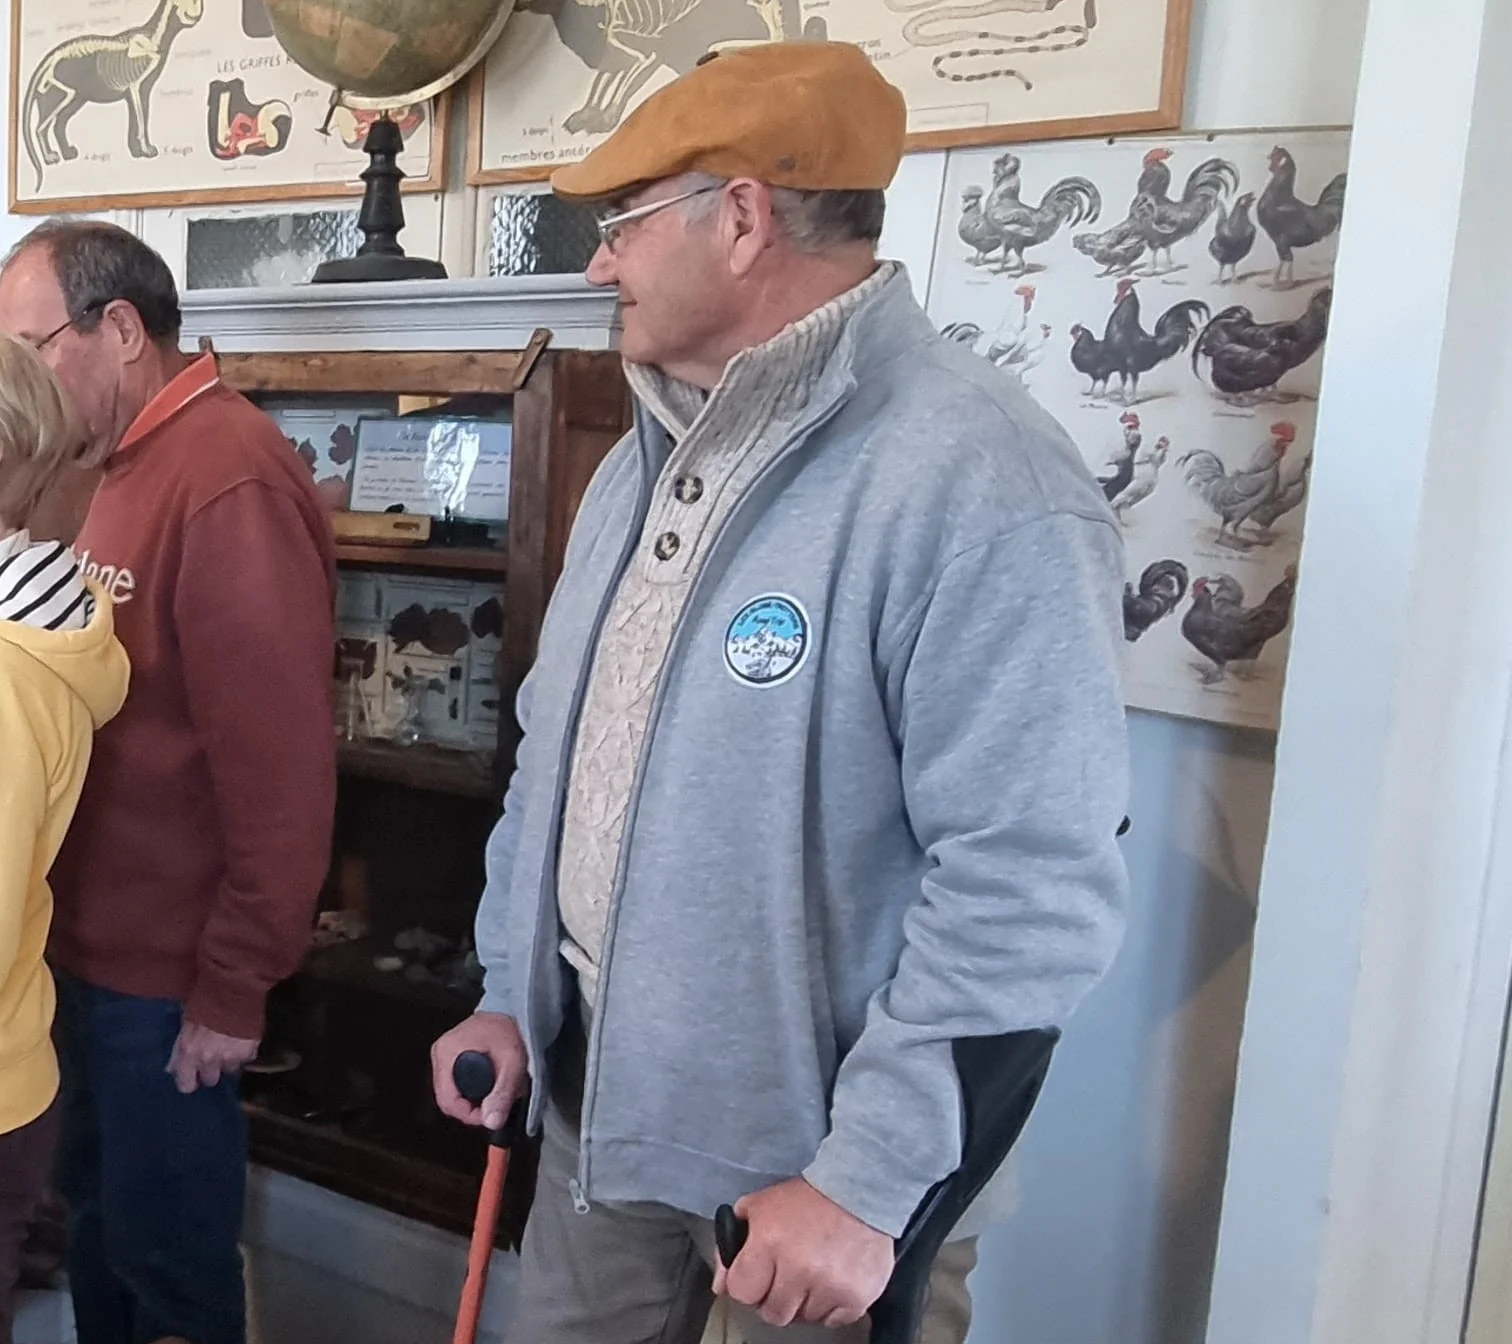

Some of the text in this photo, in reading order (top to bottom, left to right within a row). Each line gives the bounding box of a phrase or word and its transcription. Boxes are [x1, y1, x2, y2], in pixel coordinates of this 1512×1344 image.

[216, 58, 235, 74] LES
[239, 56, 282, 71] GRIFFES
[501, 149, 556, 164] membres
